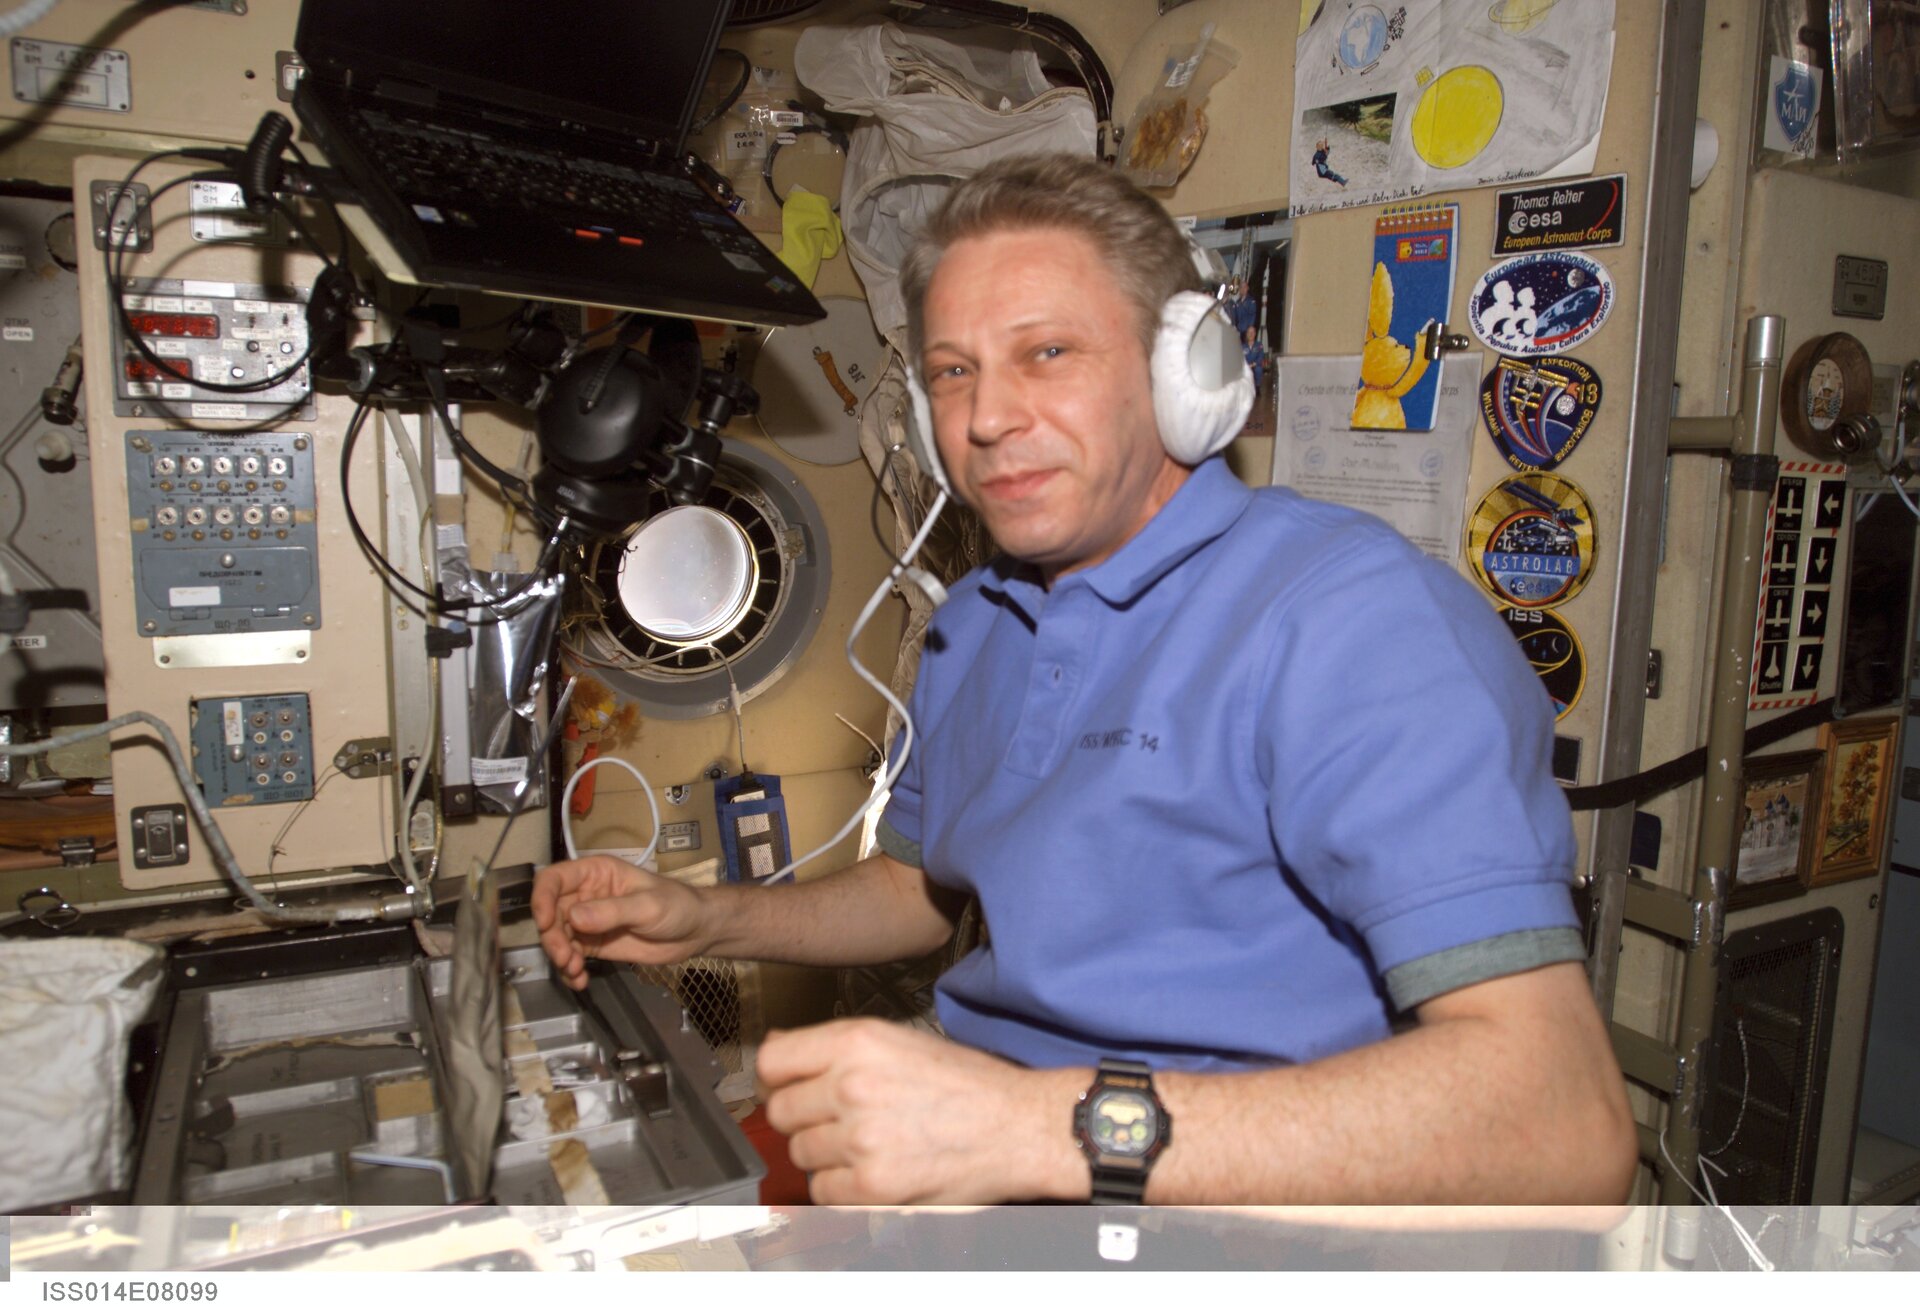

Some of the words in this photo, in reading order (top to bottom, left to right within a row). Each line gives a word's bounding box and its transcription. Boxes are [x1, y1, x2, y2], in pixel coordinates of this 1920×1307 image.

[1512, 195, 1549, 210] Thomas
[1552, 189, 1584, 206] Reiter
[1503, 234, 1540, 250] European
[1542, 229, 1585, 244] Astronaut
[1586, 226, 1613, 242] Corps
[1484, 253, 1537, 284] European
[1540, 251, 1600, 275] Astronauts
[1470, 294, 1486, 335] Sapientia
[1485, 334, 1519, 352] Populus
[1520, 344, 1556, 354] Audacia
[1558, 328, 1590, 349] Cultura
[1591, 281, 1612, 329] Exploratio
[1541, 357, 1592, 381] EXPEDITION
[1576, 382, 1599, 405] 13
[1482, 390, 1501, 437] WILLIAMS
[1508, 453, 1540, 472] REITER
[1491, 555, 1574, 577] ASTROLAB
[1509, 609, 1543, 623] ISS
